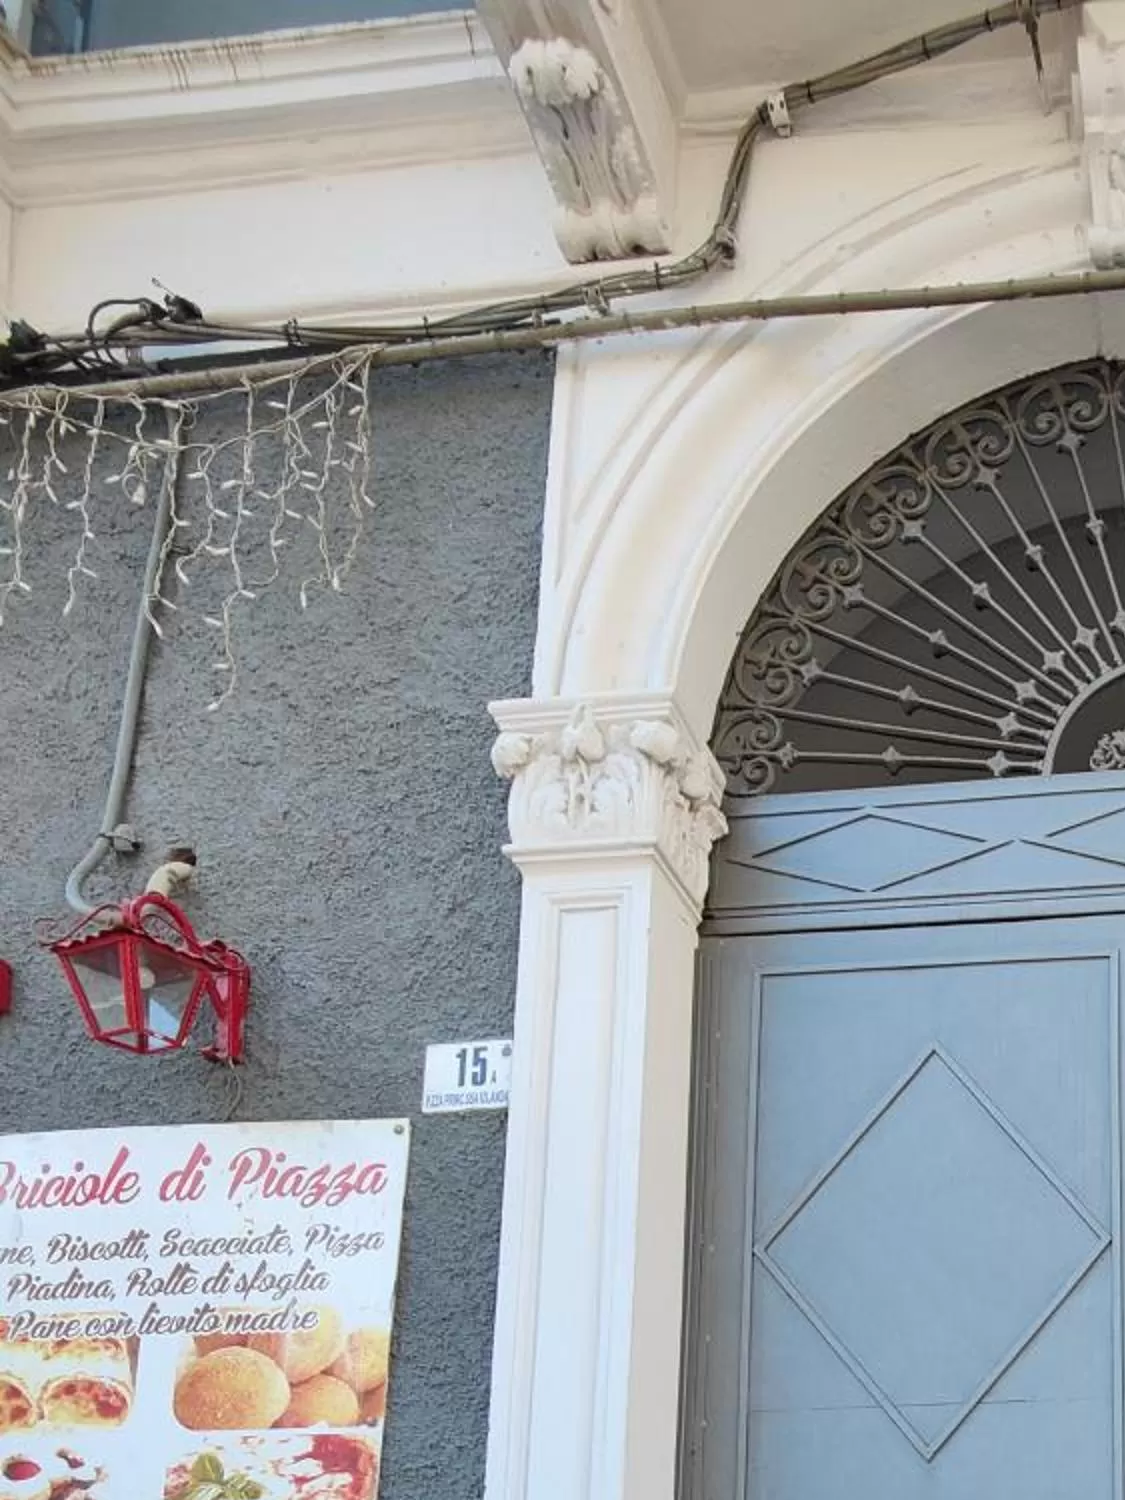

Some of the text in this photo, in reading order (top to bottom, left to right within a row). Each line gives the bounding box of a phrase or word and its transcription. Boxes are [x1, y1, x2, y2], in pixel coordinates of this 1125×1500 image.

[159, 1141, 212, 1202] di
[228, 1147, 389, 1207] Piazza
[47, 1229, 150, 1265] Biscotti,
[159, 1224, 294, 1259] Scacciate,
[305, 1223, 385, 1258] Pizza
[7, 1267, 117, 1301] Piadina,
[201, 1260, 233, 1294] di
[234, 1258, 330, 1301] sfoglia
[10, 1300, 319, 1339] Pane con lievito madre
